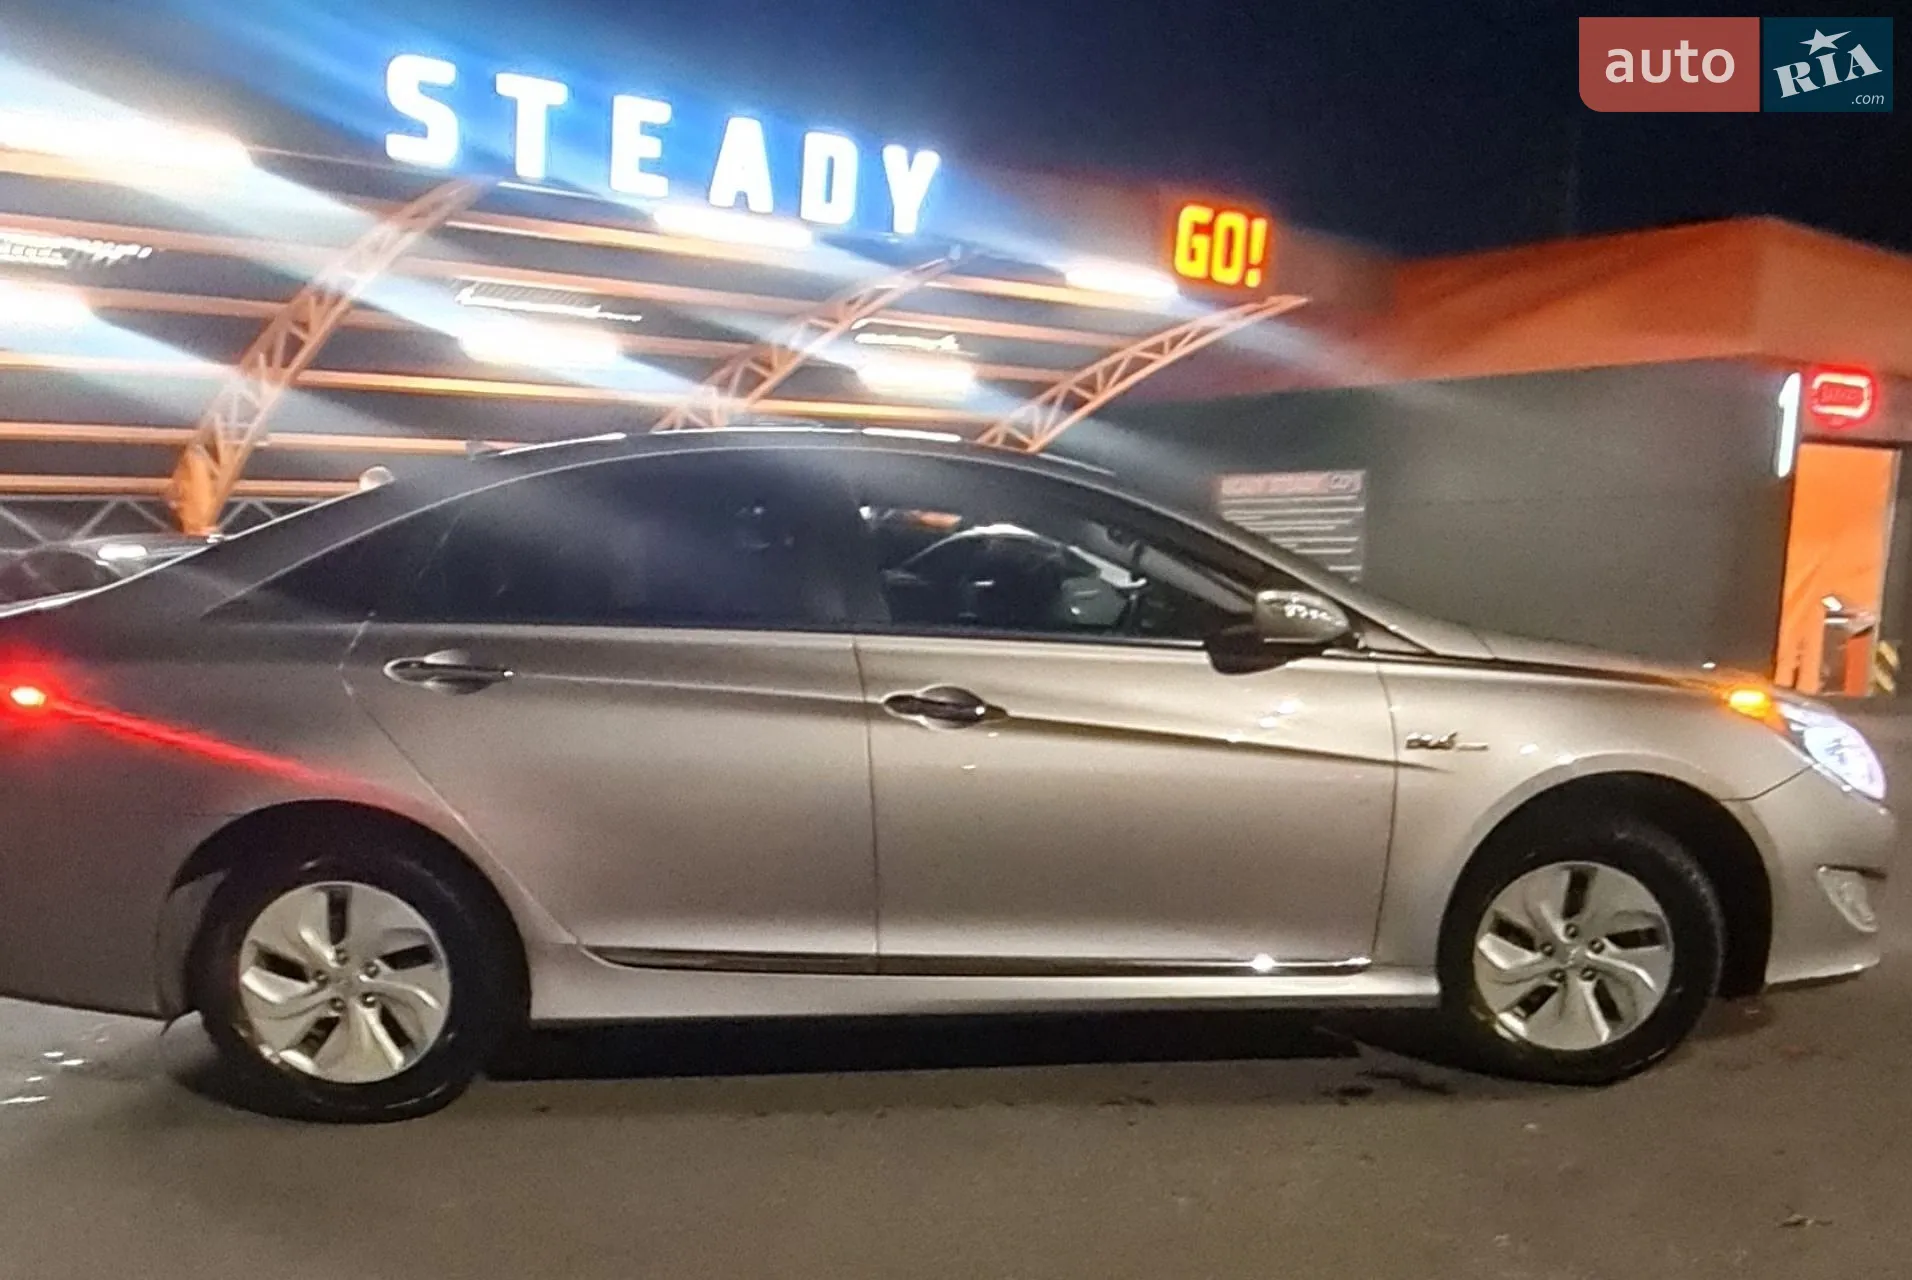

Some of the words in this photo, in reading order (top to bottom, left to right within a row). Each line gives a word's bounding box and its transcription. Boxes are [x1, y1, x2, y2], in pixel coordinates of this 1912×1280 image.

[385, 54, 940, 234] STEADY
[1174, 205, 1268, 288] GO!
[1778, 371, 1800, 478] 1
